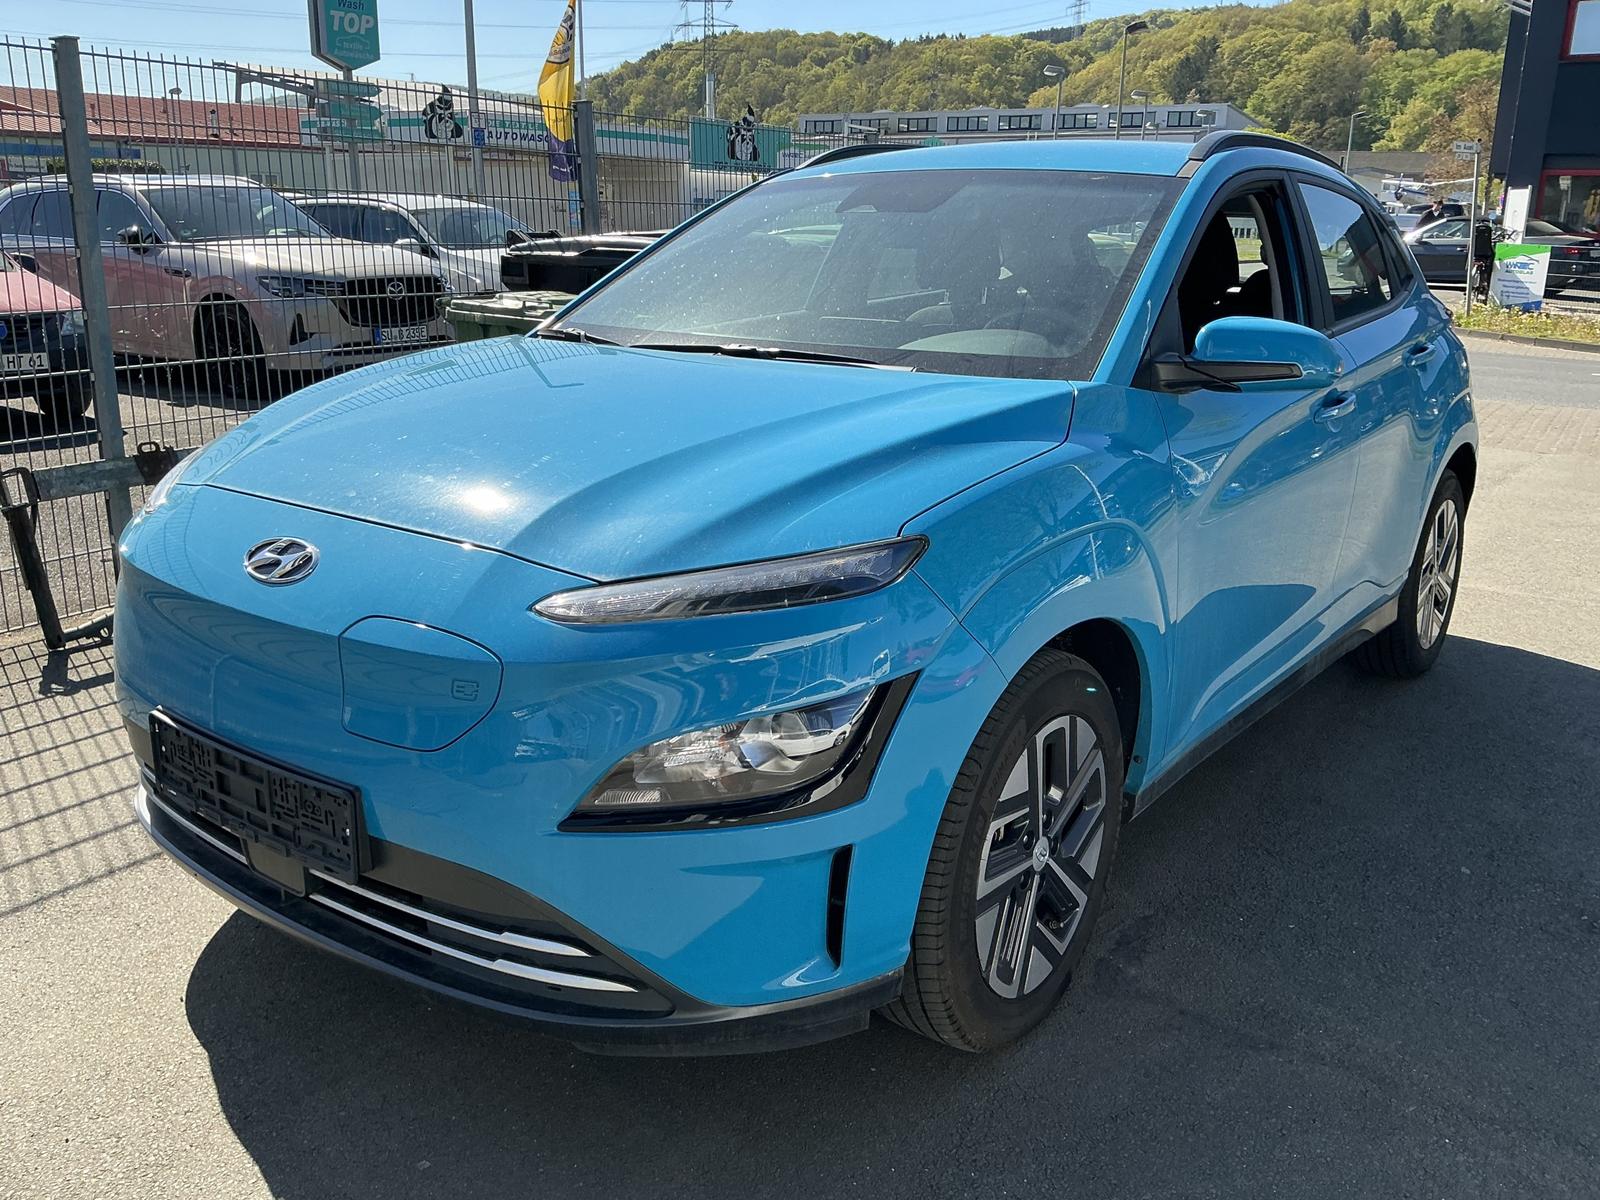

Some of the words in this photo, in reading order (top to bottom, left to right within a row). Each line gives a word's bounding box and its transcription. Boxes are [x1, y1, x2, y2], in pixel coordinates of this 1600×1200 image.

[338, 0, 364, 11] Wash
[330, 10, 374, 34] TOP
[487, 131, 550, 143] AUTOWASC
